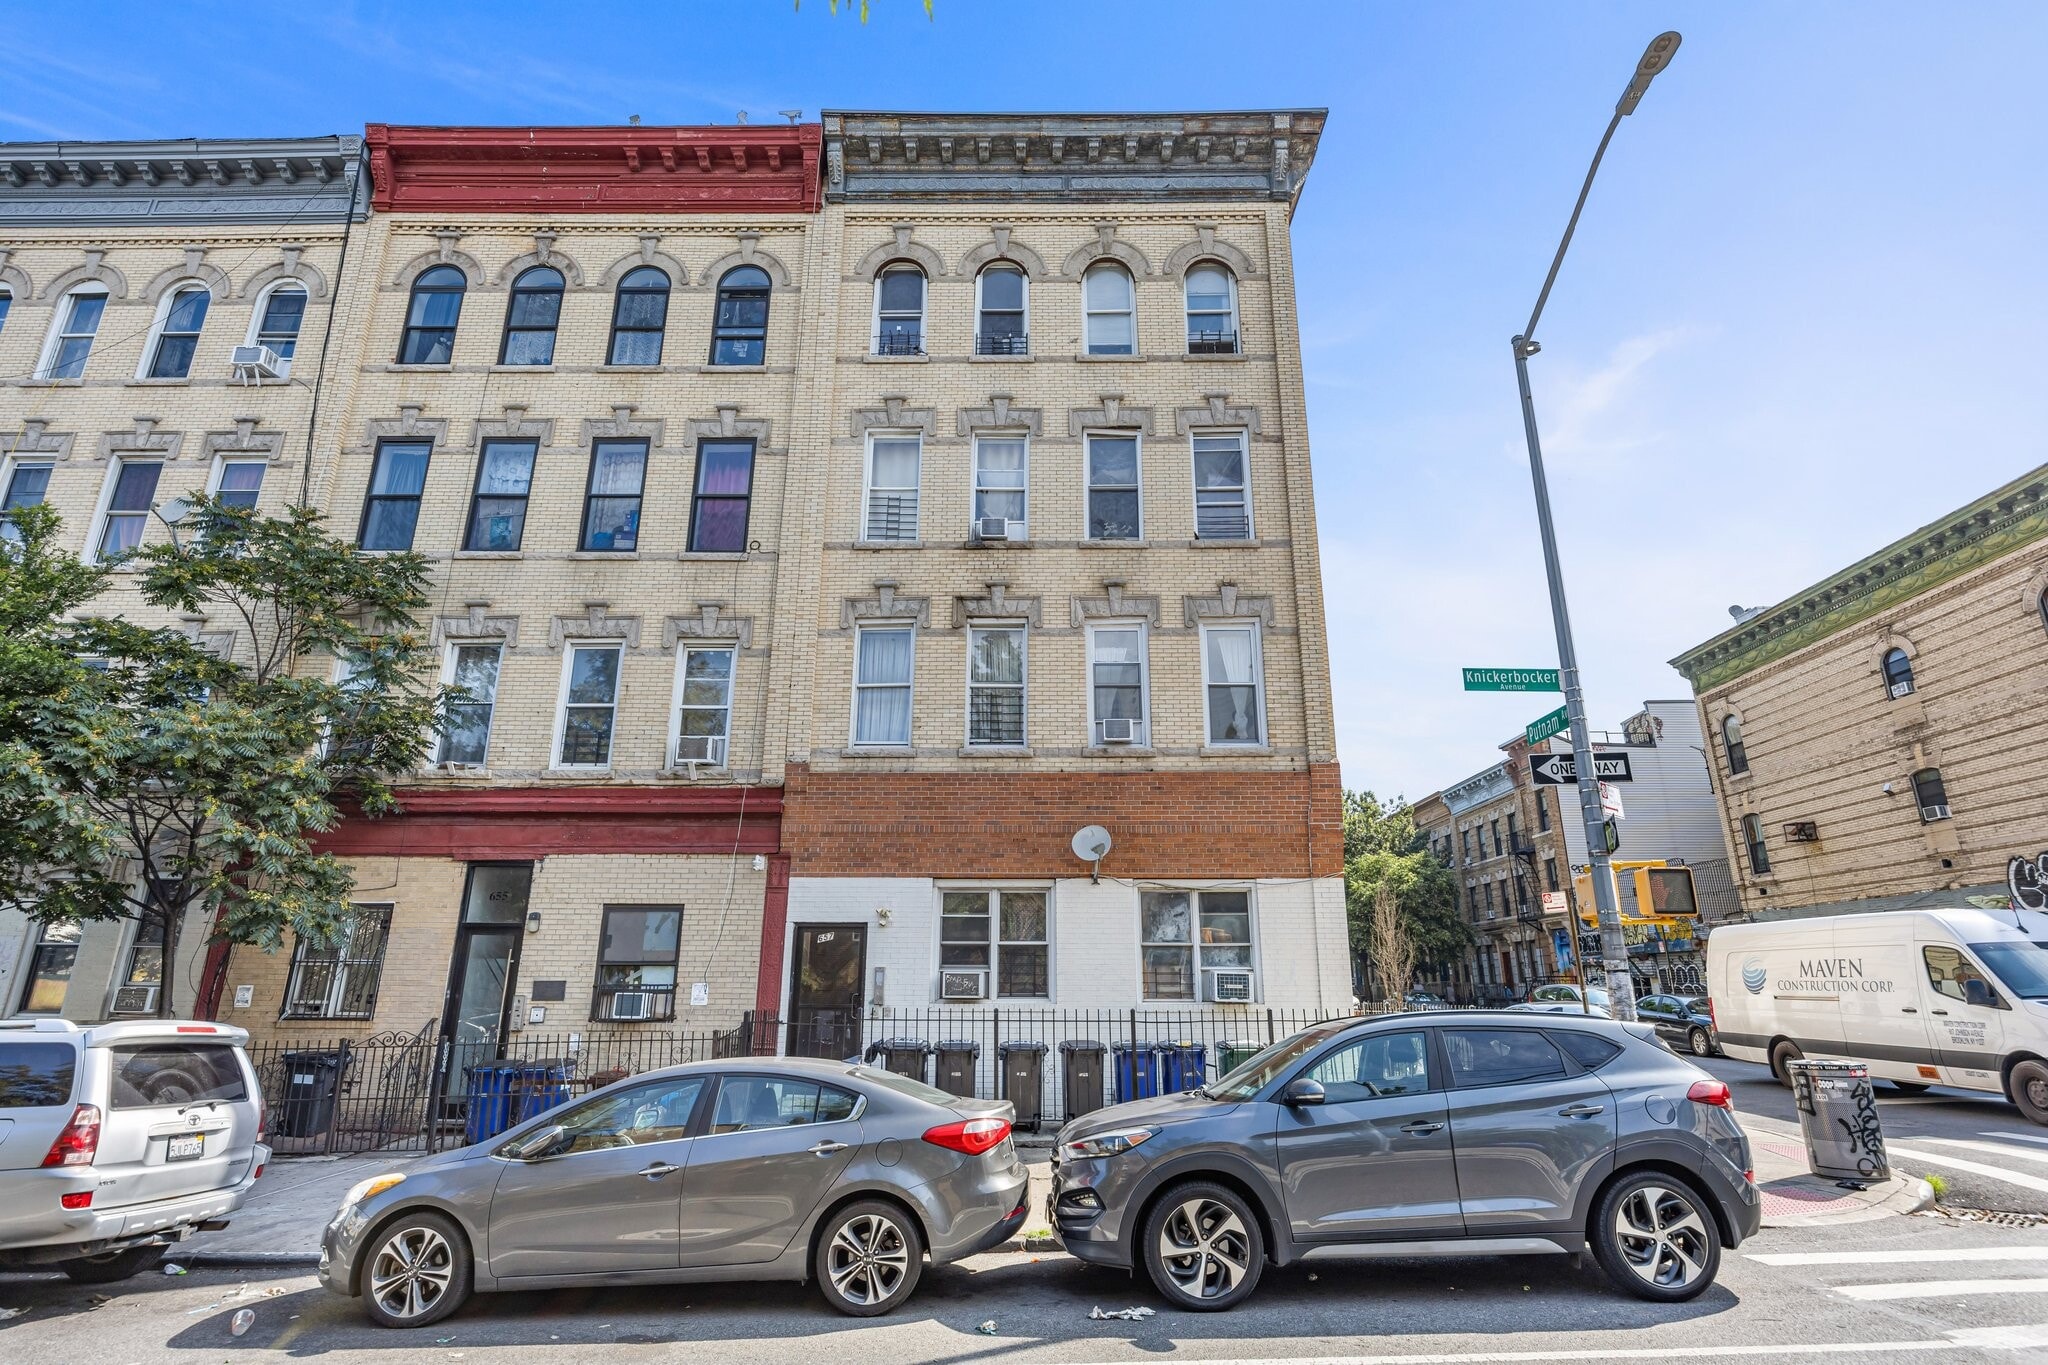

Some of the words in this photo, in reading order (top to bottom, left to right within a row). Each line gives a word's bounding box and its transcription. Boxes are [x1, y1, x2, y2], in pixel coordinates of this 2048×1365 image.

[1466, 671, 1557, 683] Knickerbocker
[1528, 715, 1559, 742] Putnam
[1551, 764, 1576, 775] ONE
[489, 891, 510, 901] 655
[818, 932, 834, 942] 657
[1800, 958, 1863, 978] MAVEN
[1777, 980, 1858, 993] CONSTRUCTION
[1861, 981, 1895, 993] CORP.
